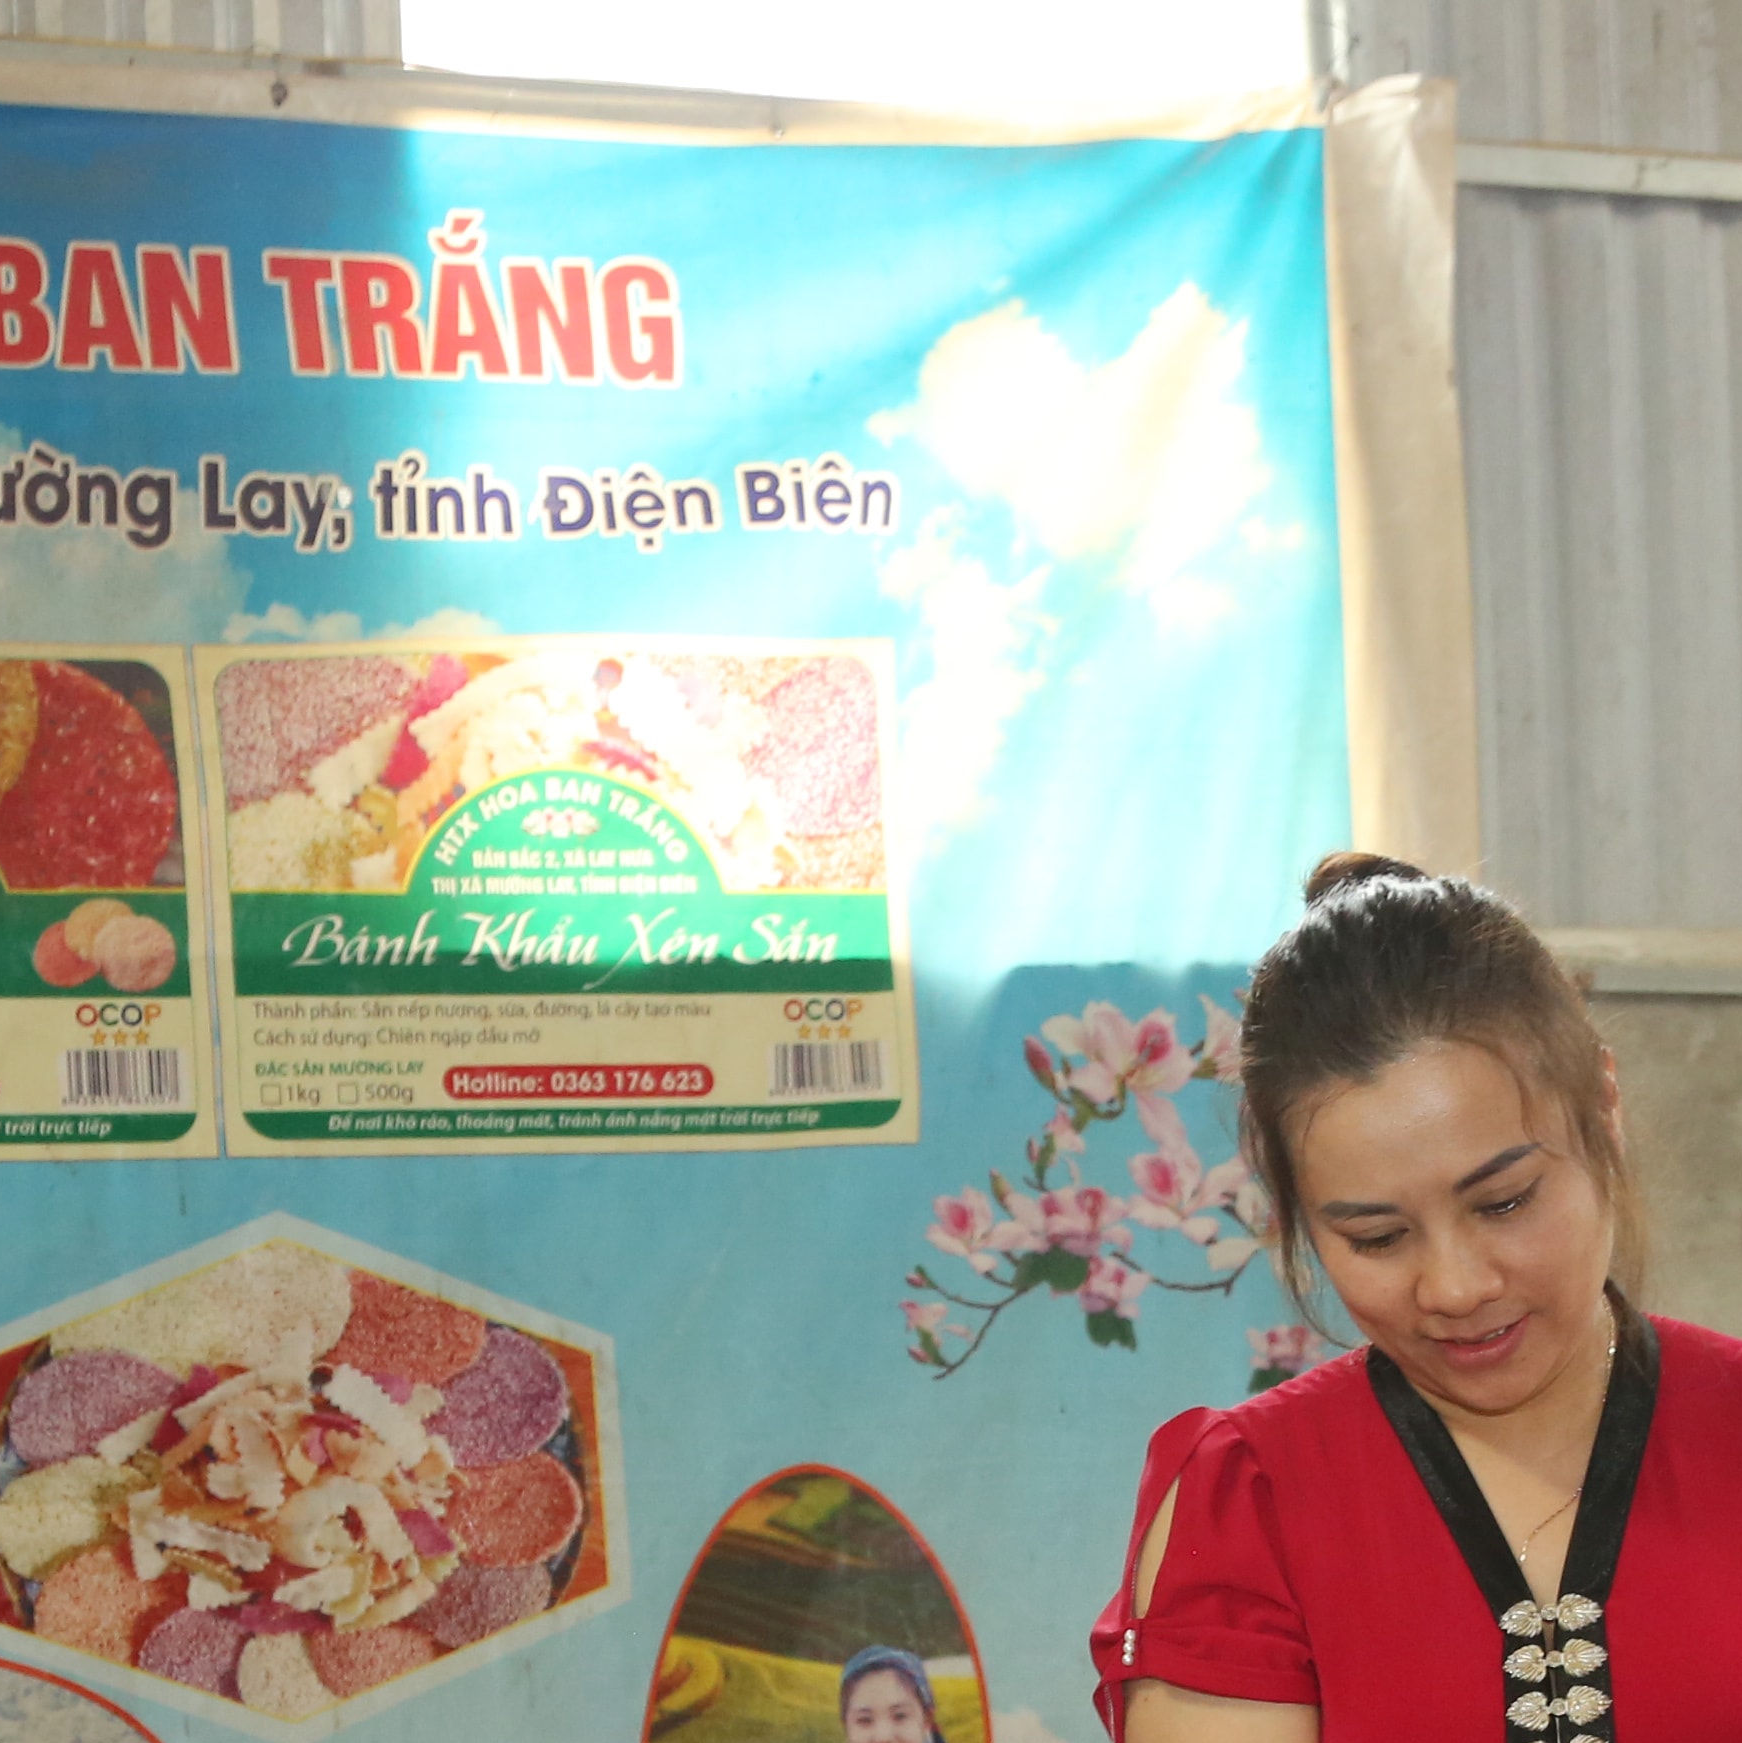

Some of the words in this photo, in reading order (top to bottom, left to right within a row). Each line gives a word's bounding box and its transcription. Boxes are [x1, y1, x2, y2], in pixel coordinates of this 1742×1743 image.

[265, 209, 683, 390] TRẮNG
[369, 448, 522, 541] tỉnh
[539, 463, 717, 550] Điện
[741, 454, 897, 534] Biên
[434, 811, 481, 866] HTX
[478, 780, 539, 821] HOA
[544, 777, 603, 806] BAN
[282, 908, 441, 968] Bánh
[460, 907, 600, 972] Khẩu
[733, 913, 839, 965] Sắn
[76, 1003, 161, 1027] OCOP
[783, 999, 864, 1021] OCOP
[287, 1083, 321, 1105] 1kg
[364, 1083, 414, 1105] 500g
[452, 1073, 544, 1095] Hotline:
[550, 1071, 606, 1093] 0363
[614, 1070, 655, 1092] 176
[661, 1069, 704, 1092] 623
